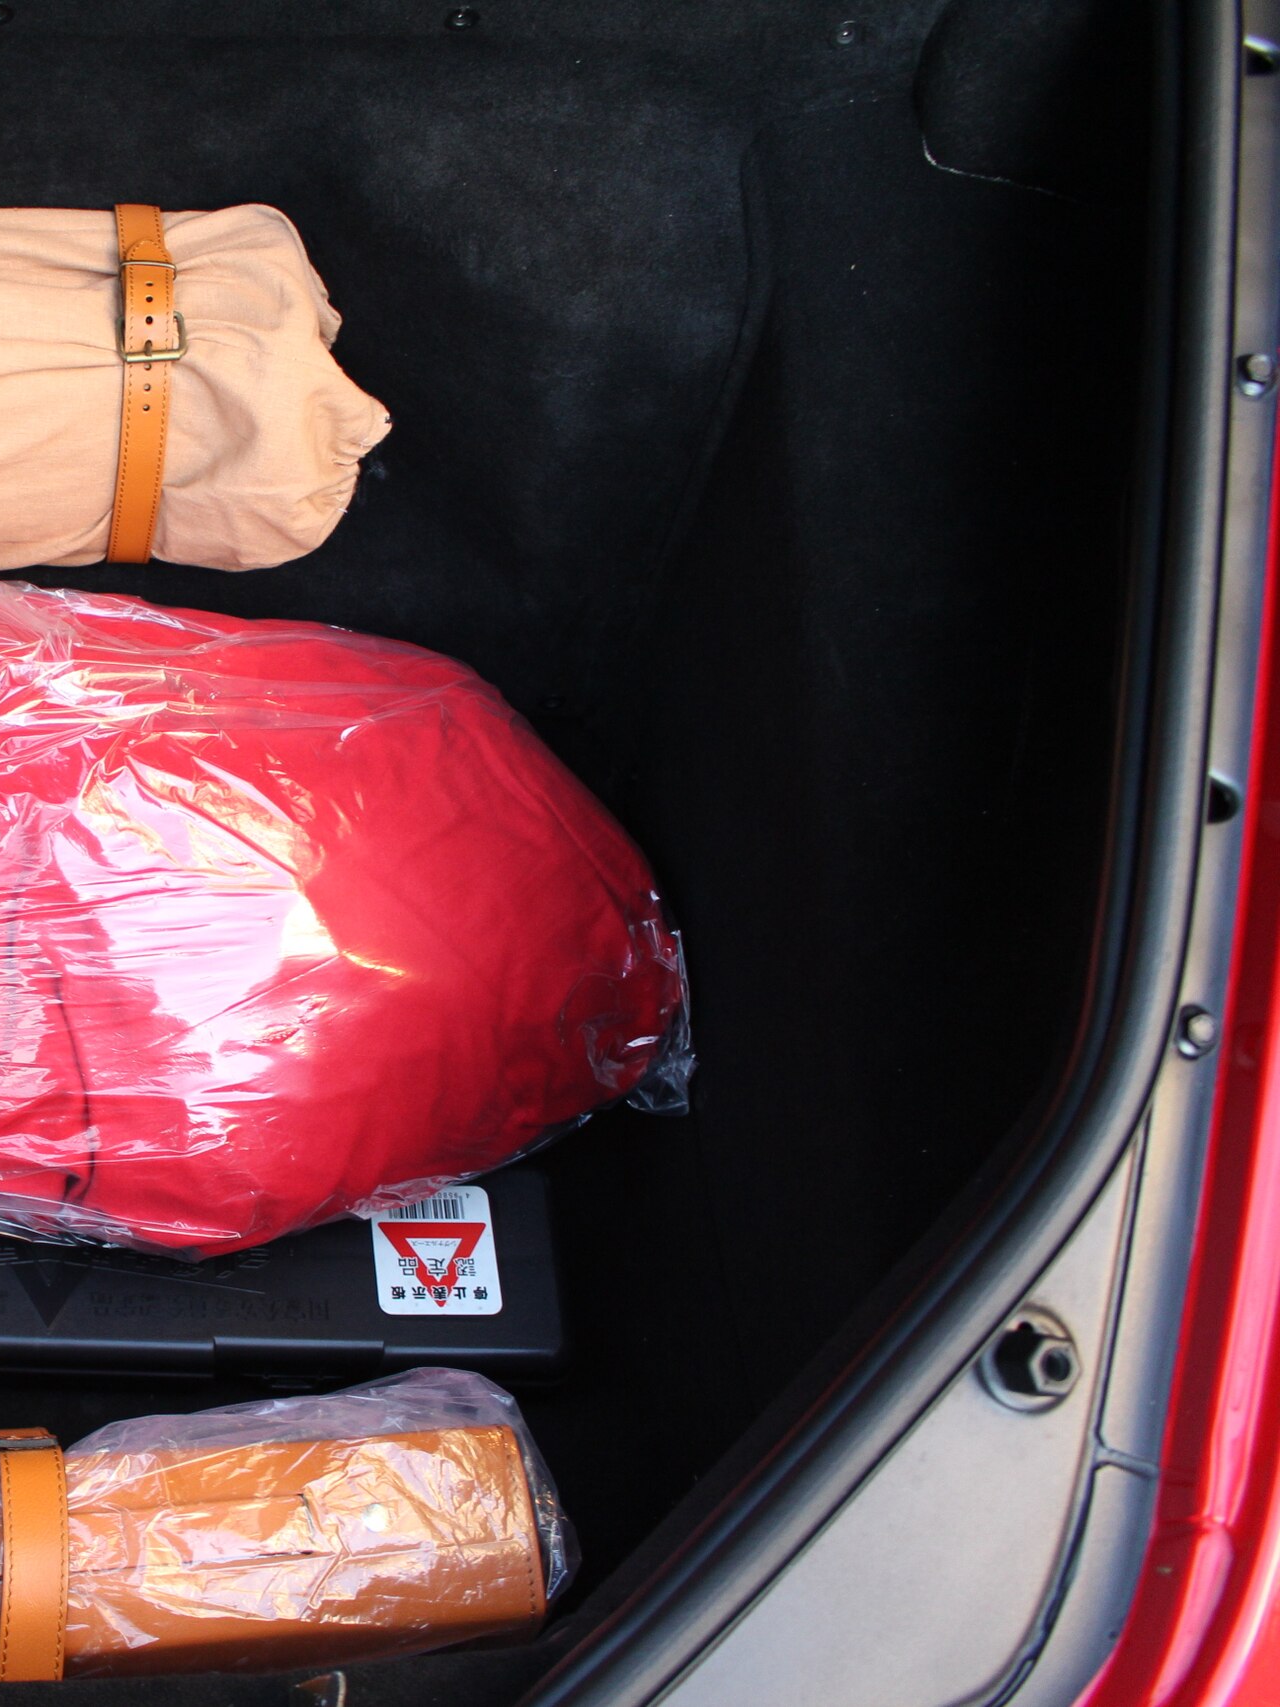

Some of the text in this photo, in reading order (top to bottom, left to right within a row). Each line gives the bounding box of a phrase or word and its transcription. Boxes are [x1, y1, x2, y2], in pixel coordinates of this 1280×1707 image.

[398, 1258, 477, 1277] 認定品
[391, 1286, 488, 1300] 停止表示板
